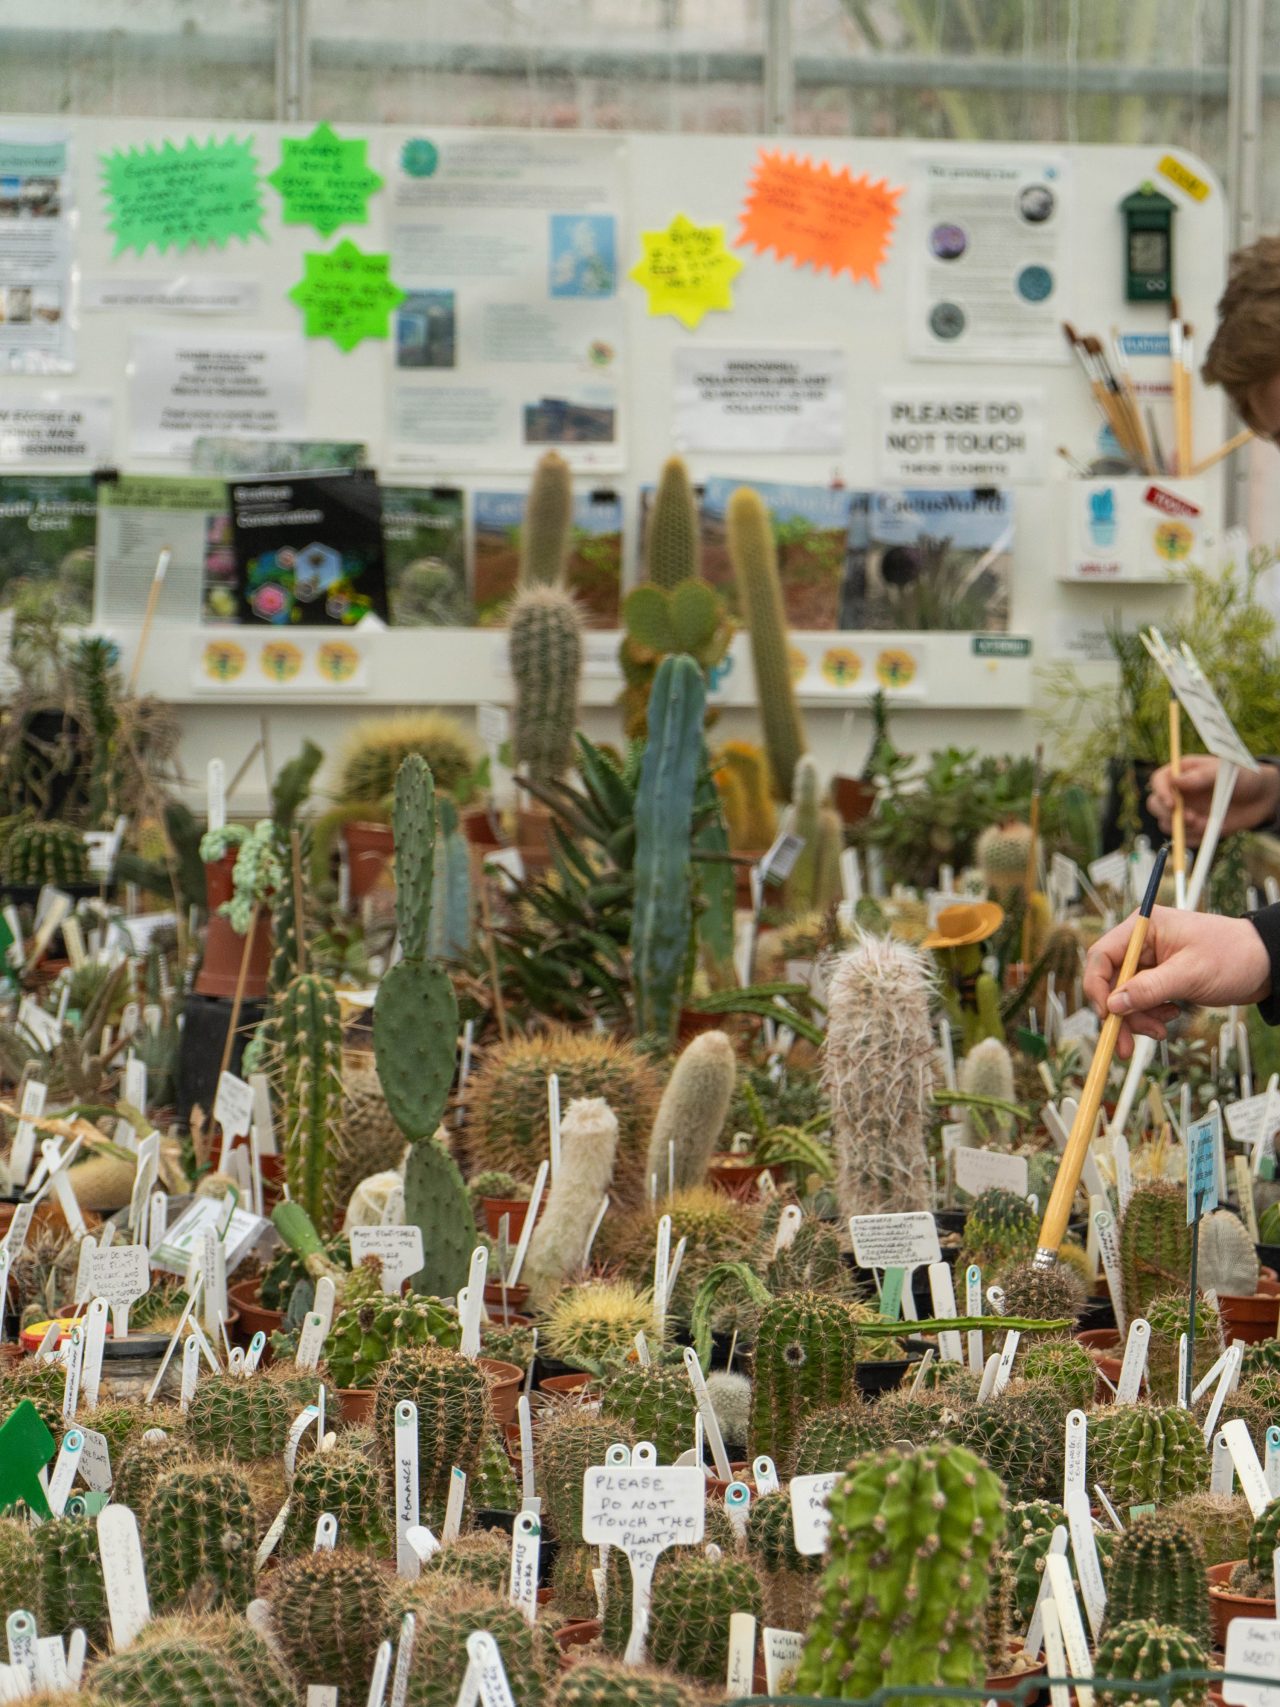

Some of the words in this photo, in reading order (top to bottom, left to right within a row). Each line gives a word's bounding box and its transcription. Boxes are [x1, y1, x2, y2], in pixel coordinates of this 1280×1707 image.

[891, 402, 979, 425] PLEASE
[985, 402, 1024, 425] DO
[886, 432, 936, 453] NOT
[944, 432, 1027, 454] TOUCH
[596, 1475, 664, 1491] PLEASE
[601, 1497, 622, 1510] DO
[631, 1500, 675, 1510] NOT
[591, 1512, 648, 1527] TOUCH
[656, 1516, 697, 1528] THE
[622, 1531, 677, 1547] PLANTS
